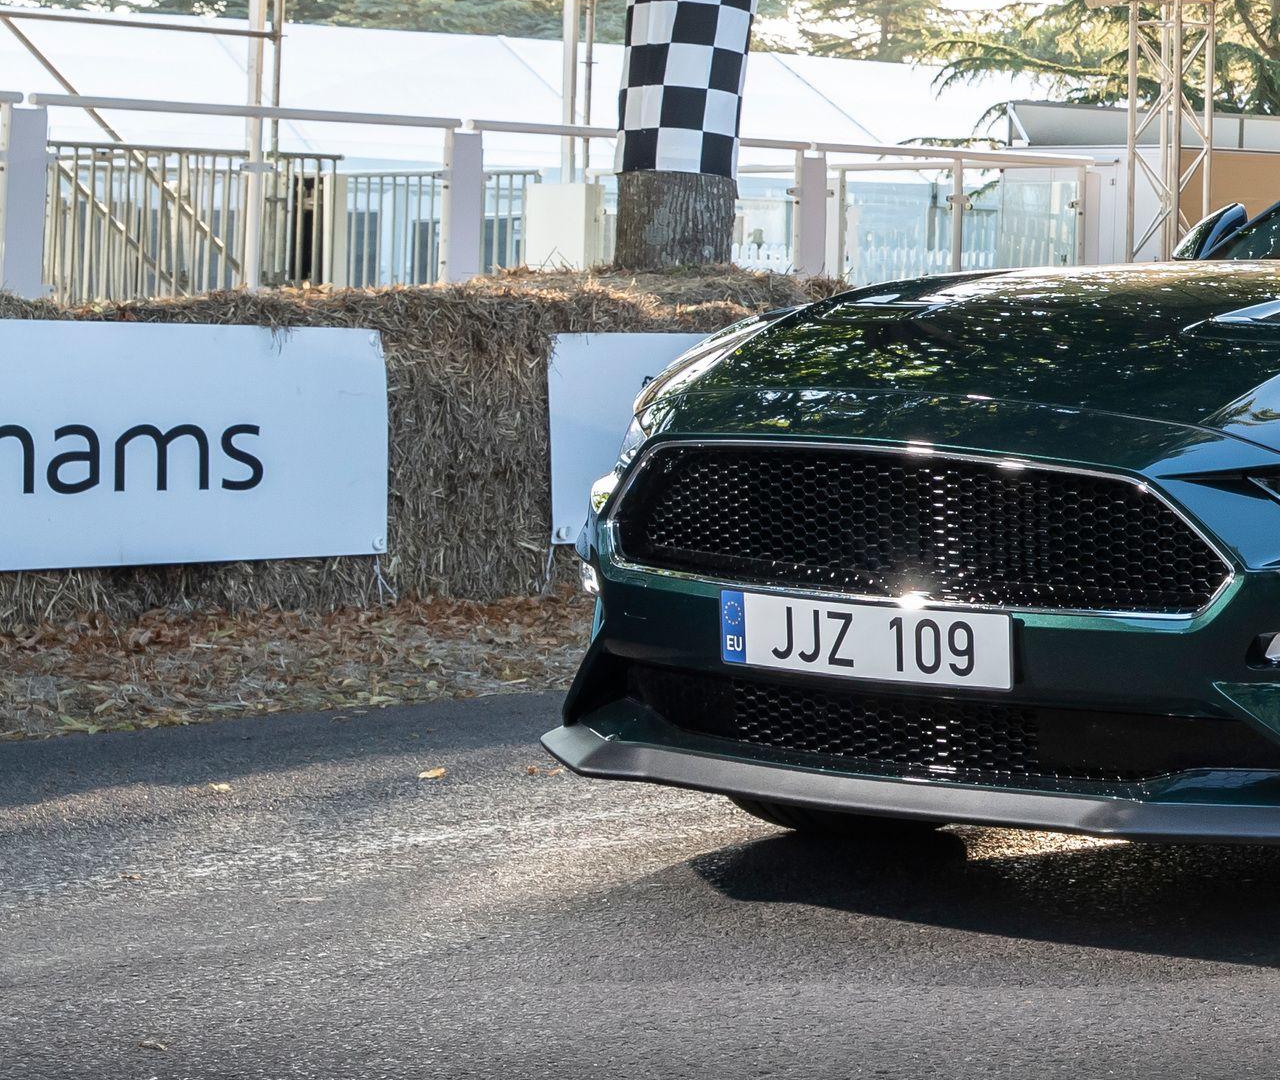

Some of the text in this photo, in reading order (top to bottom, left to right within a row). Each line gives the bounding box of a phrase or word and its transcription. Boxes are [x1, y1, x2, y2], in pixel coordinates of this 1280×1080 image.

[726, 634, 743, 652] EU
[771, 606, 975, 677] JJZ 109
